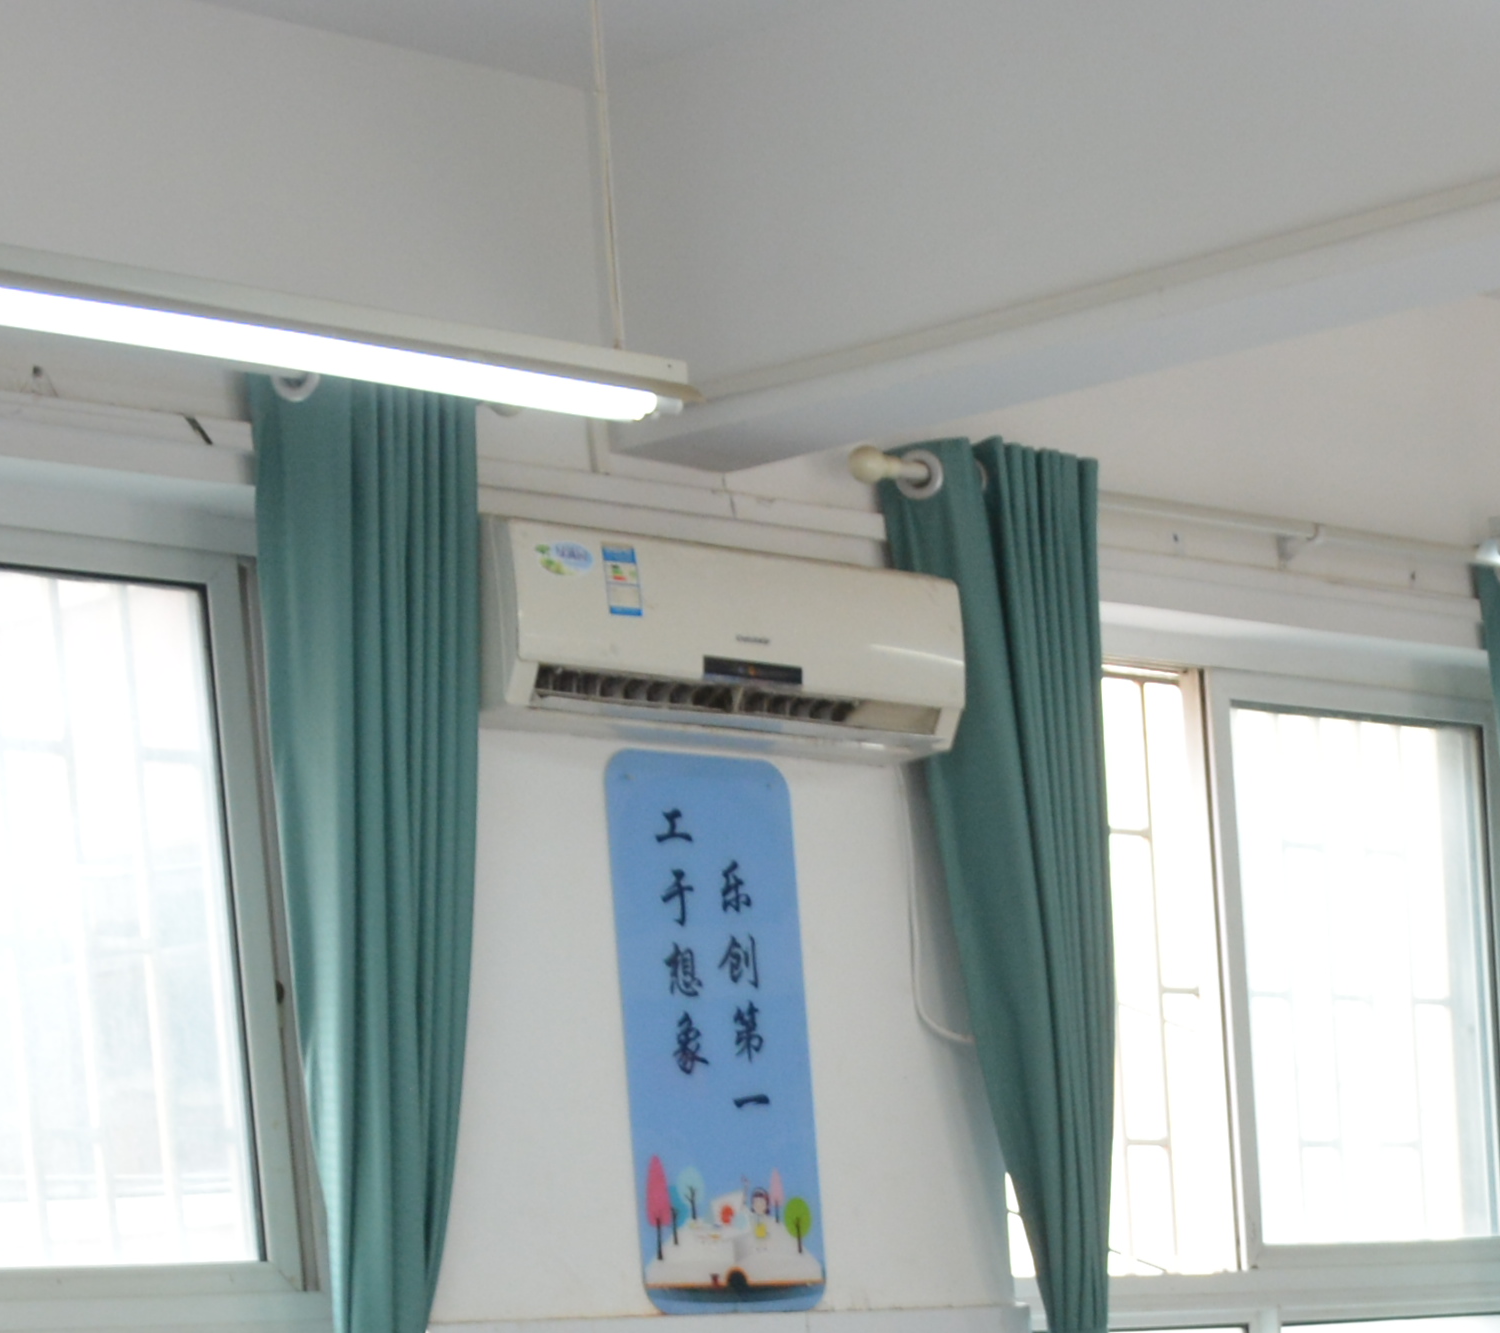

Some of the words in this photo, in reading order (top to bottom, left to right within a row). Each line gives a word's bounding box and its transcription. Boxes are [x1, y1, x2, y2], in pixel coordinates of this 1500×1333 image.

[654, 807, 711, 1076] 工于想象
[717, 860, 772, 1110] 乐创第一
